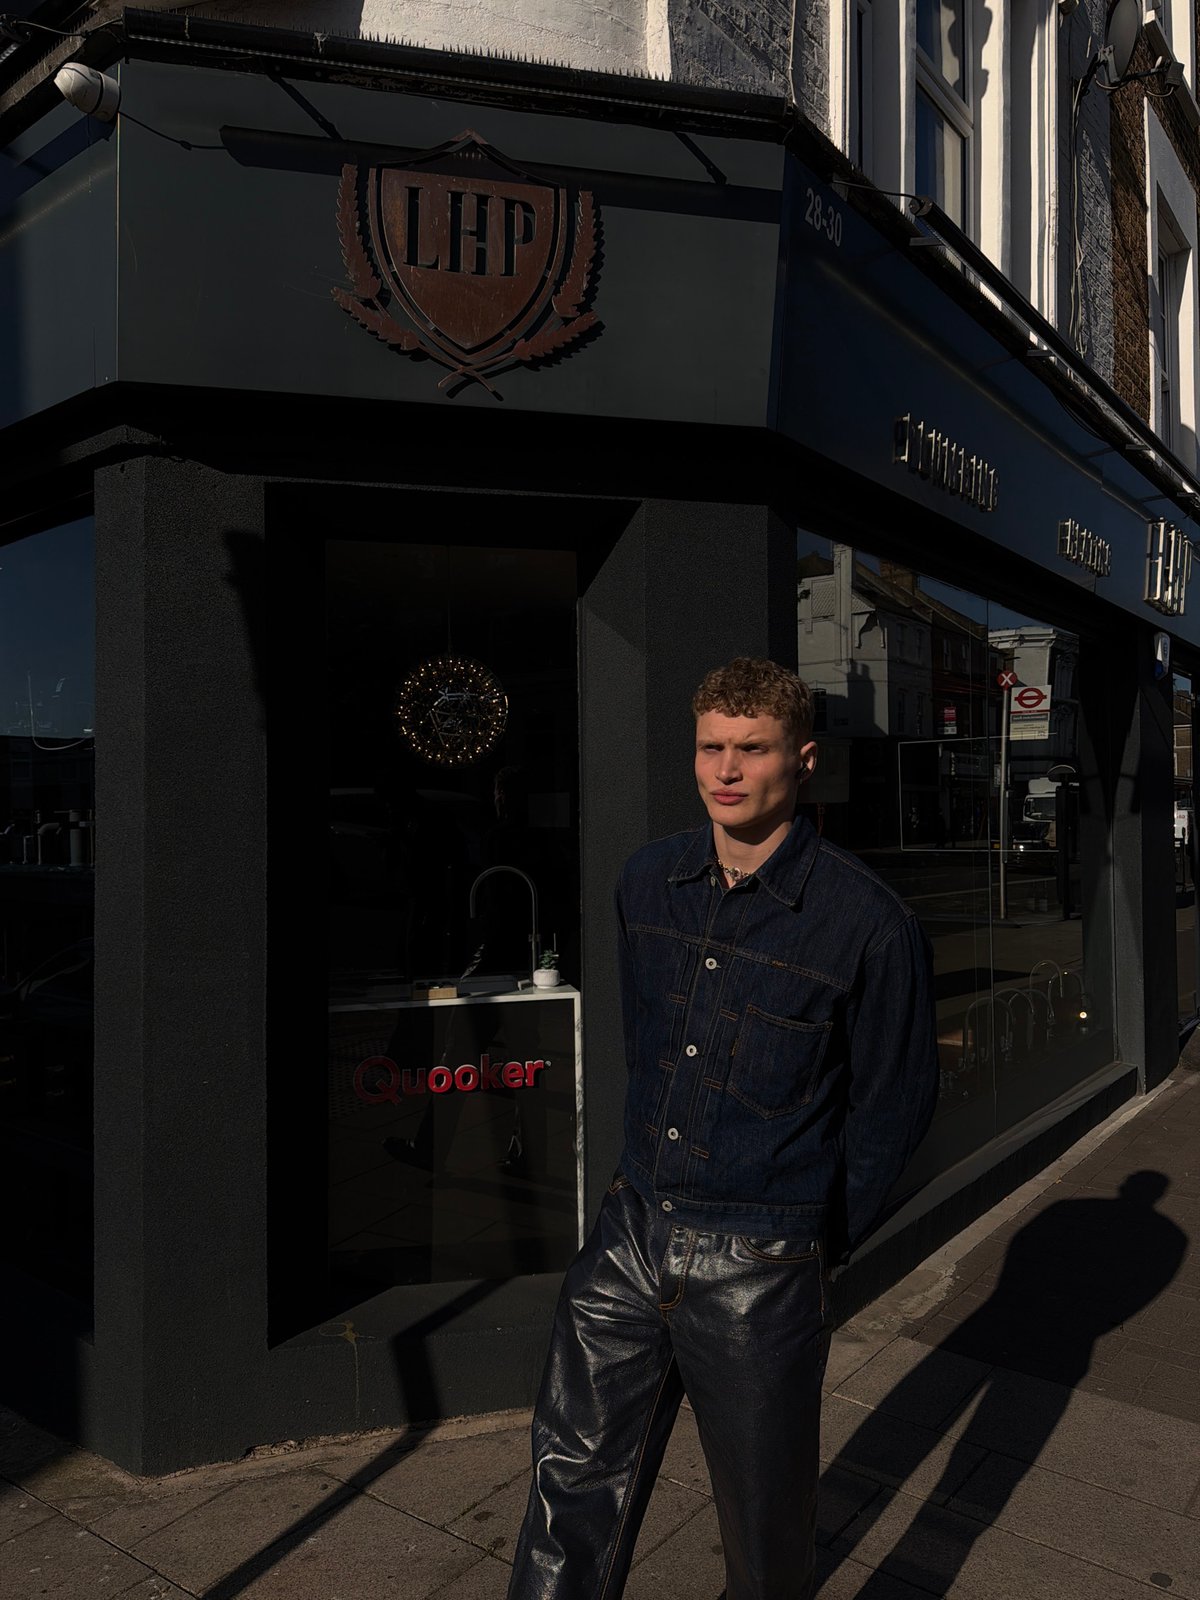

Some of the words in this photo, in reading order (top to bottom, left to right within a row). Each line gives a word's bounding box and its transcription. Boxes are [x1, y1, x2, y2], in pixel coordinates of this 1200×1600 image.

[403, 186, 537, 277] LHP
[804, 187, 843, 248] 28-30
[353, 1054, 545, 1105] Quooker
